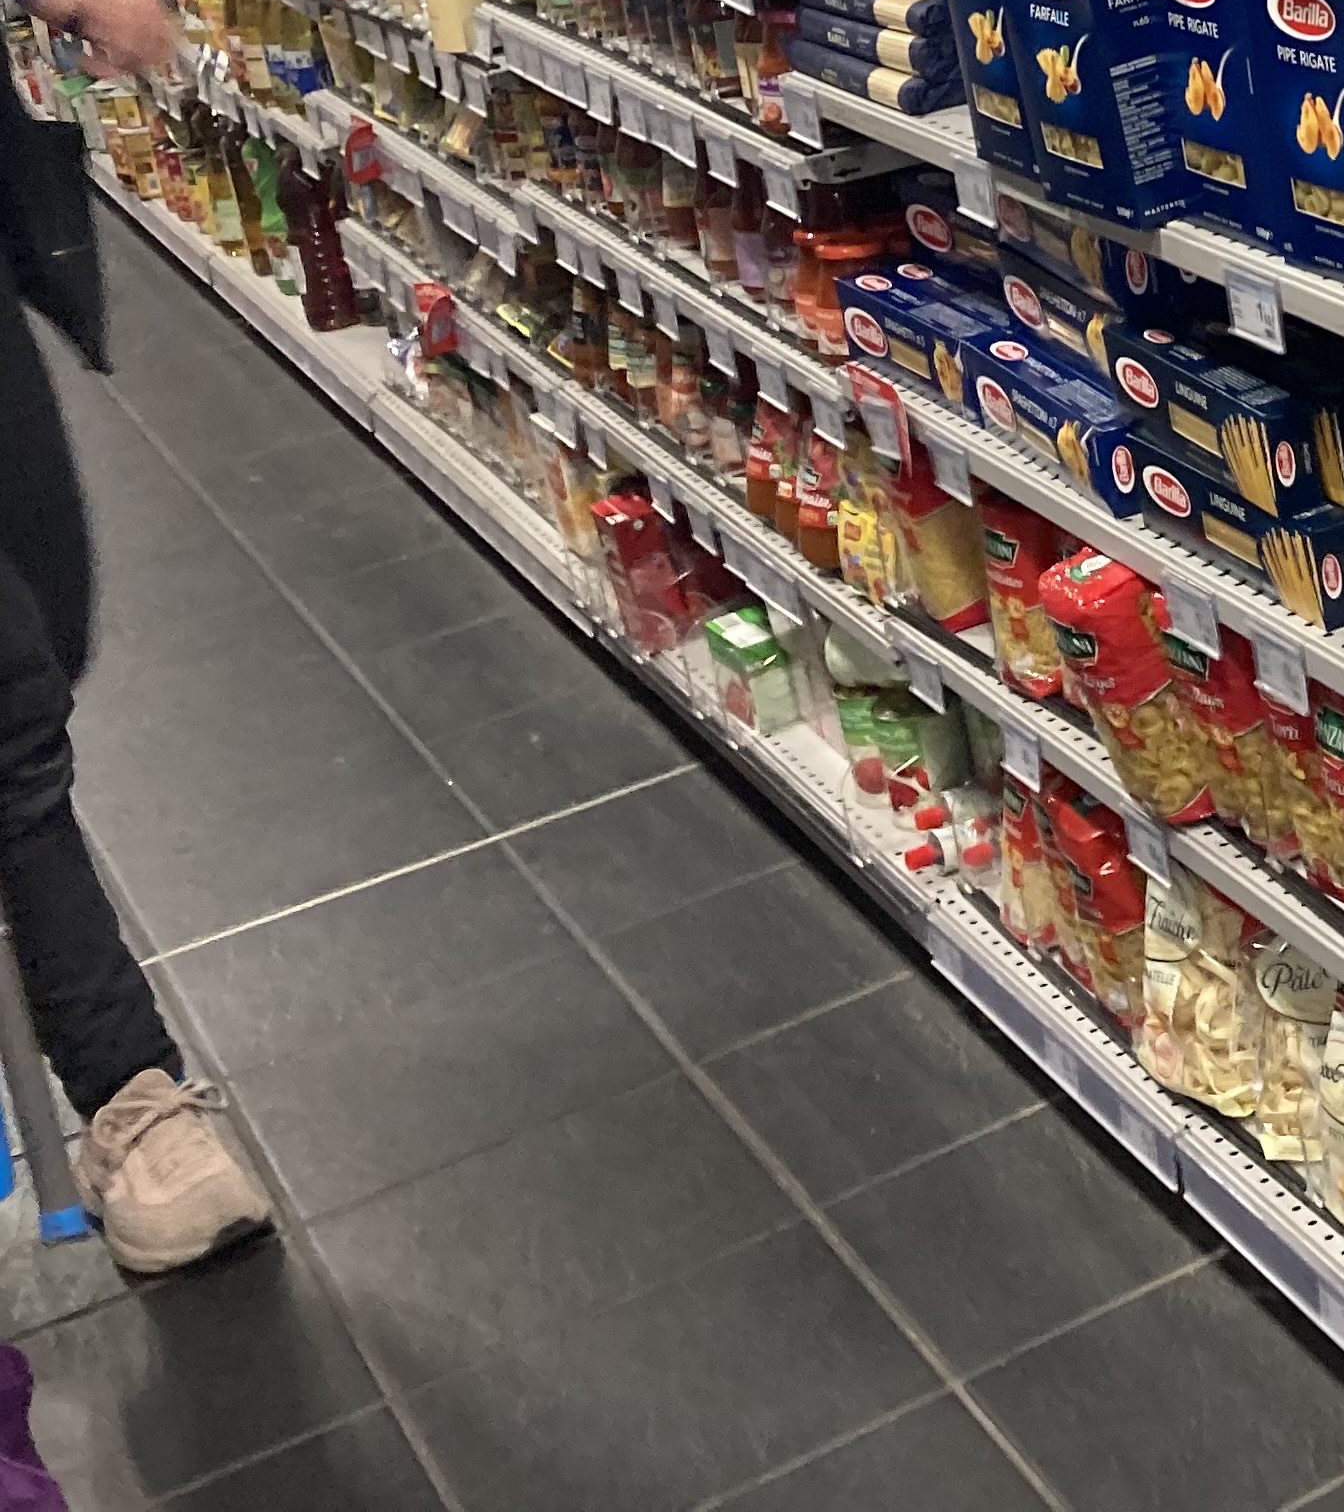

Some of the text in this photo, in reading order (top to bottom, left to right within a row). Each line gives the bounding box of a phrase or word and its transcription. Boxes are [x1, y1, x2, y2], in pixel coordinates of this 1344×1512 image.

[1029, 3, 1070, 27] FARFALLE
[1168, 12, 1219, 38] PIPE RIGATE
[1283, 0, 1330, 29] Barilla
[1276, 43, 1337, 73] PIPE RIGATE
[1151, 475, 1187, 508] Barilla
